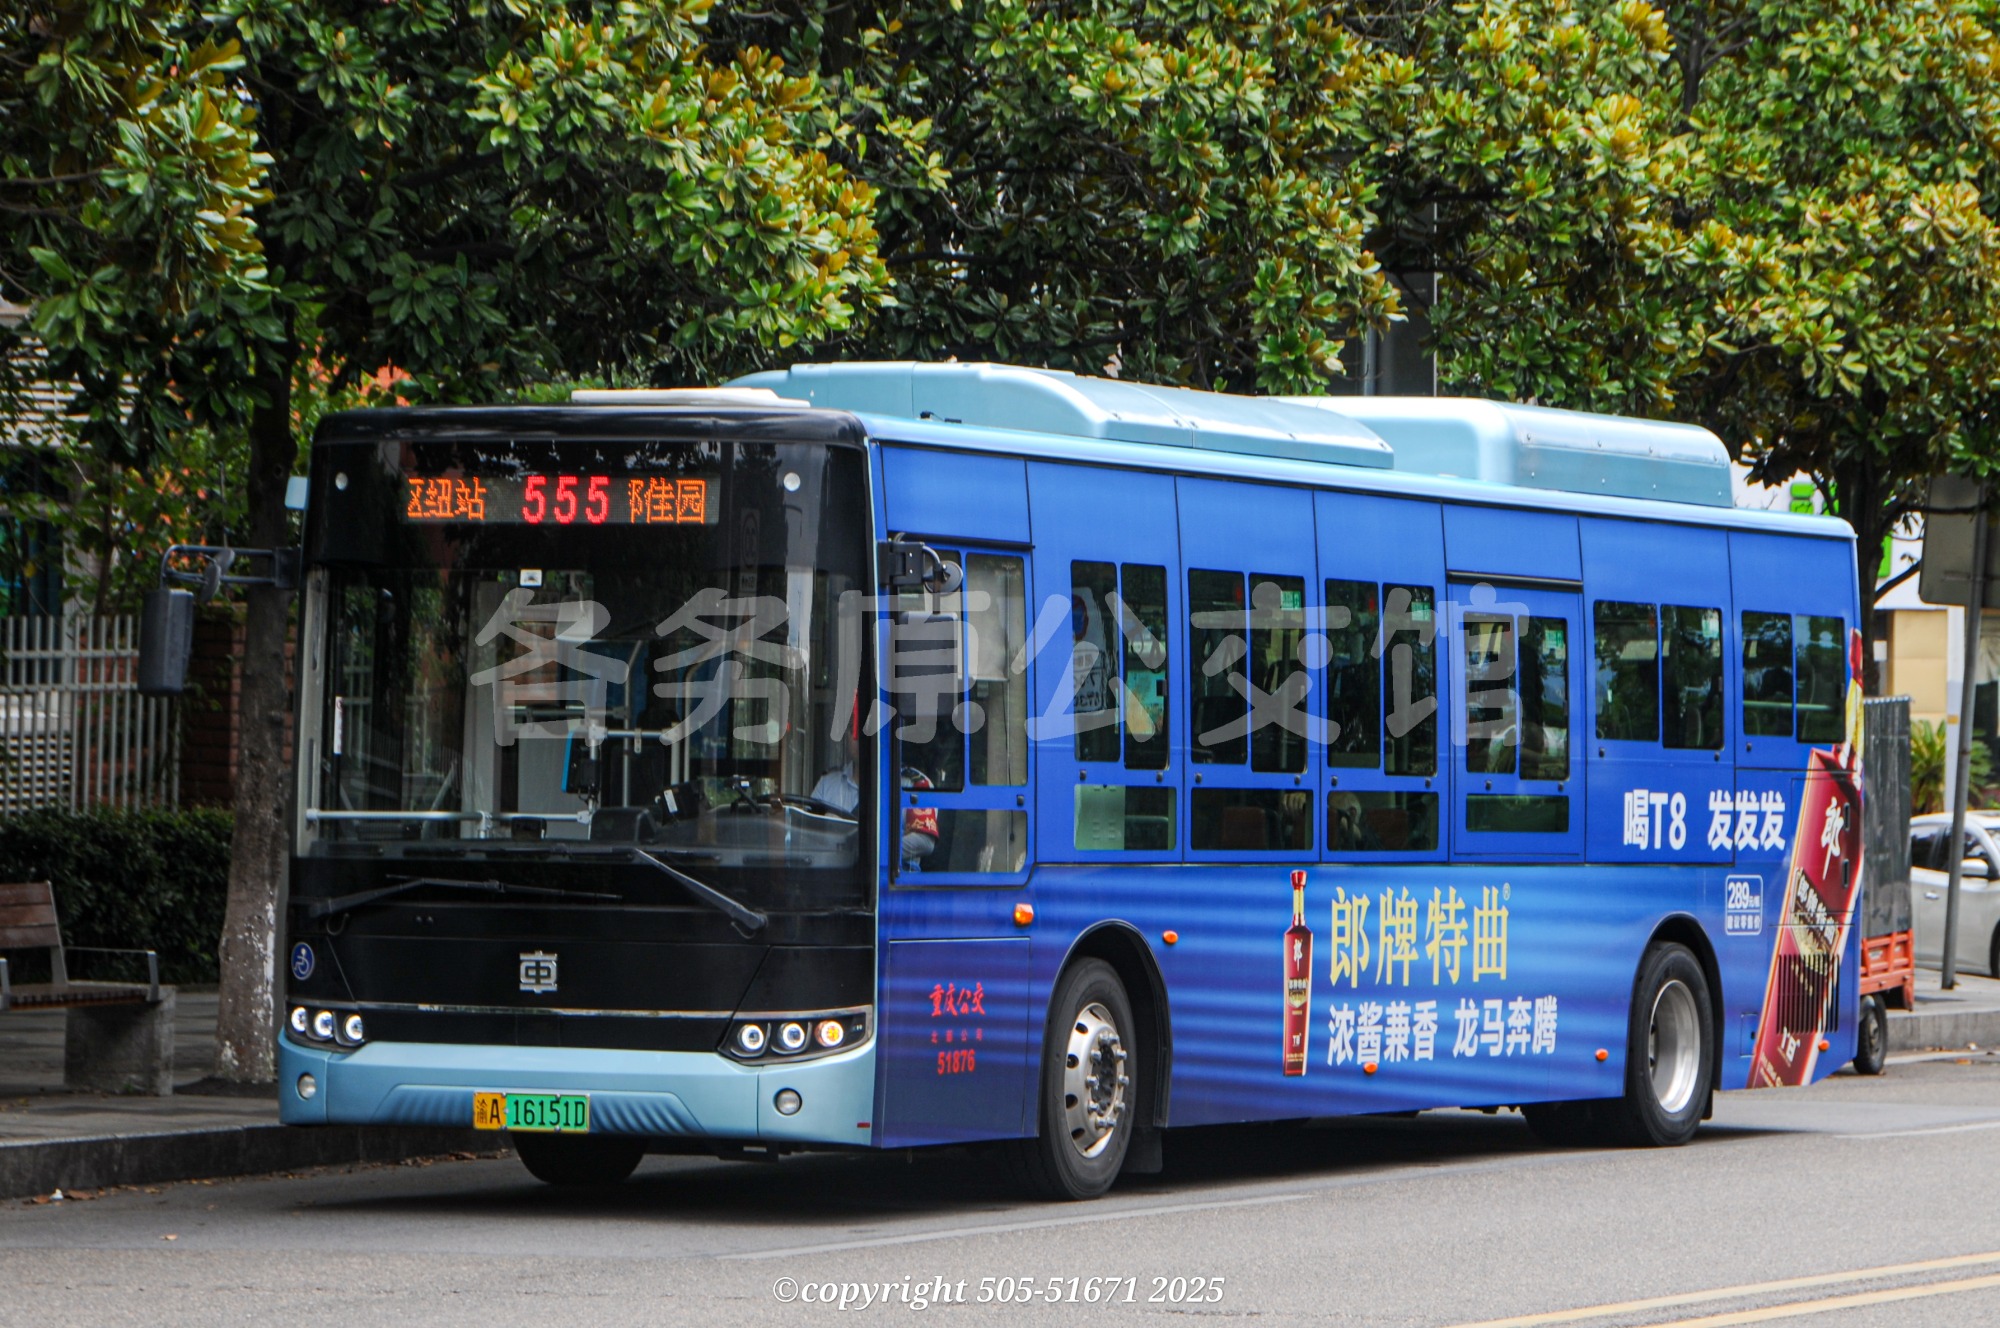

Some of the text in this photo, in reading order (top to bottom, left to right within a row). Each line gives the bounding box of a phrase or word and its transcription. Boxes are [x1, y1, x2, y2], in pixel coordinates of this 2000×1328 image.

[522, 476, 609, 524] 555
[1623, 789, 1786, 851] 喝T8 发发发
[1329, 886, 1509, 988] 郎牌特曲
[929, 982, 986, 1017] 重庆公交
[1327, 995, 1558, 1066] 浓酱兼香 龙马奔腾
[937, 1049, 975, 1075] 51876
